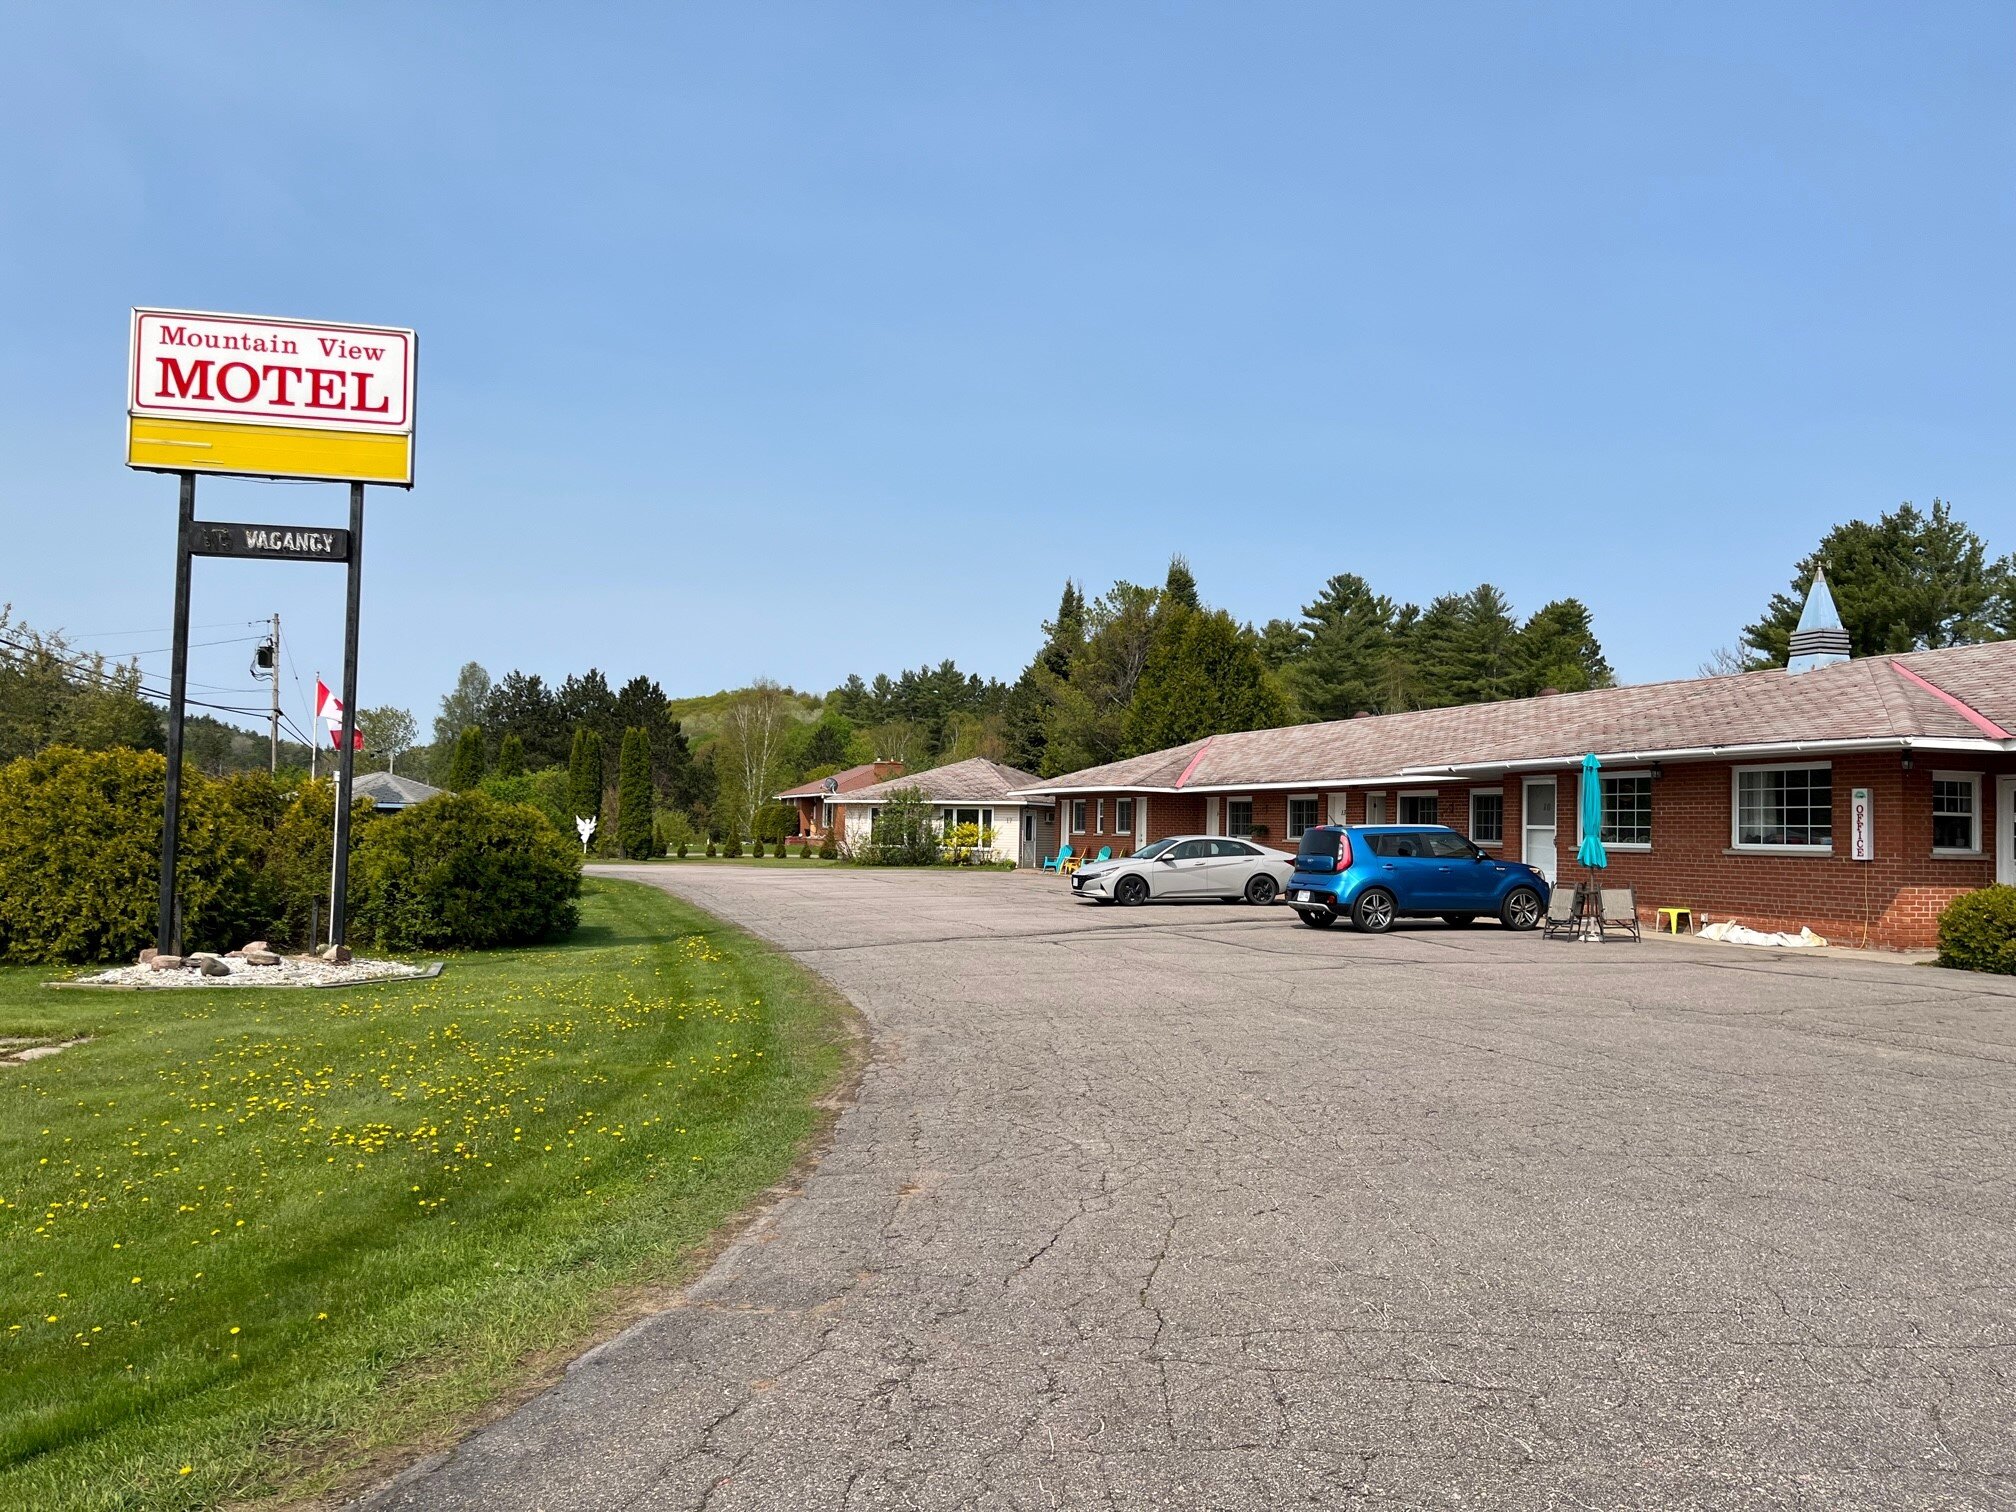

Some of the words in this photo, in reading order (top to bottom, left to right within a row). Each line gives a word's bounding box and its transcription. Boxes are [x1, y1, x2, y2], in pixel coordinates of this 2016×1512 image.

[159, 325, 299, 355] Mountain
[317, 337, 386, 361] View
[154, 356, 389, 413] MOTEL
[245, 529, 334, 553] VACANCY
[1856, 804, 1864, 857] OFFICE
